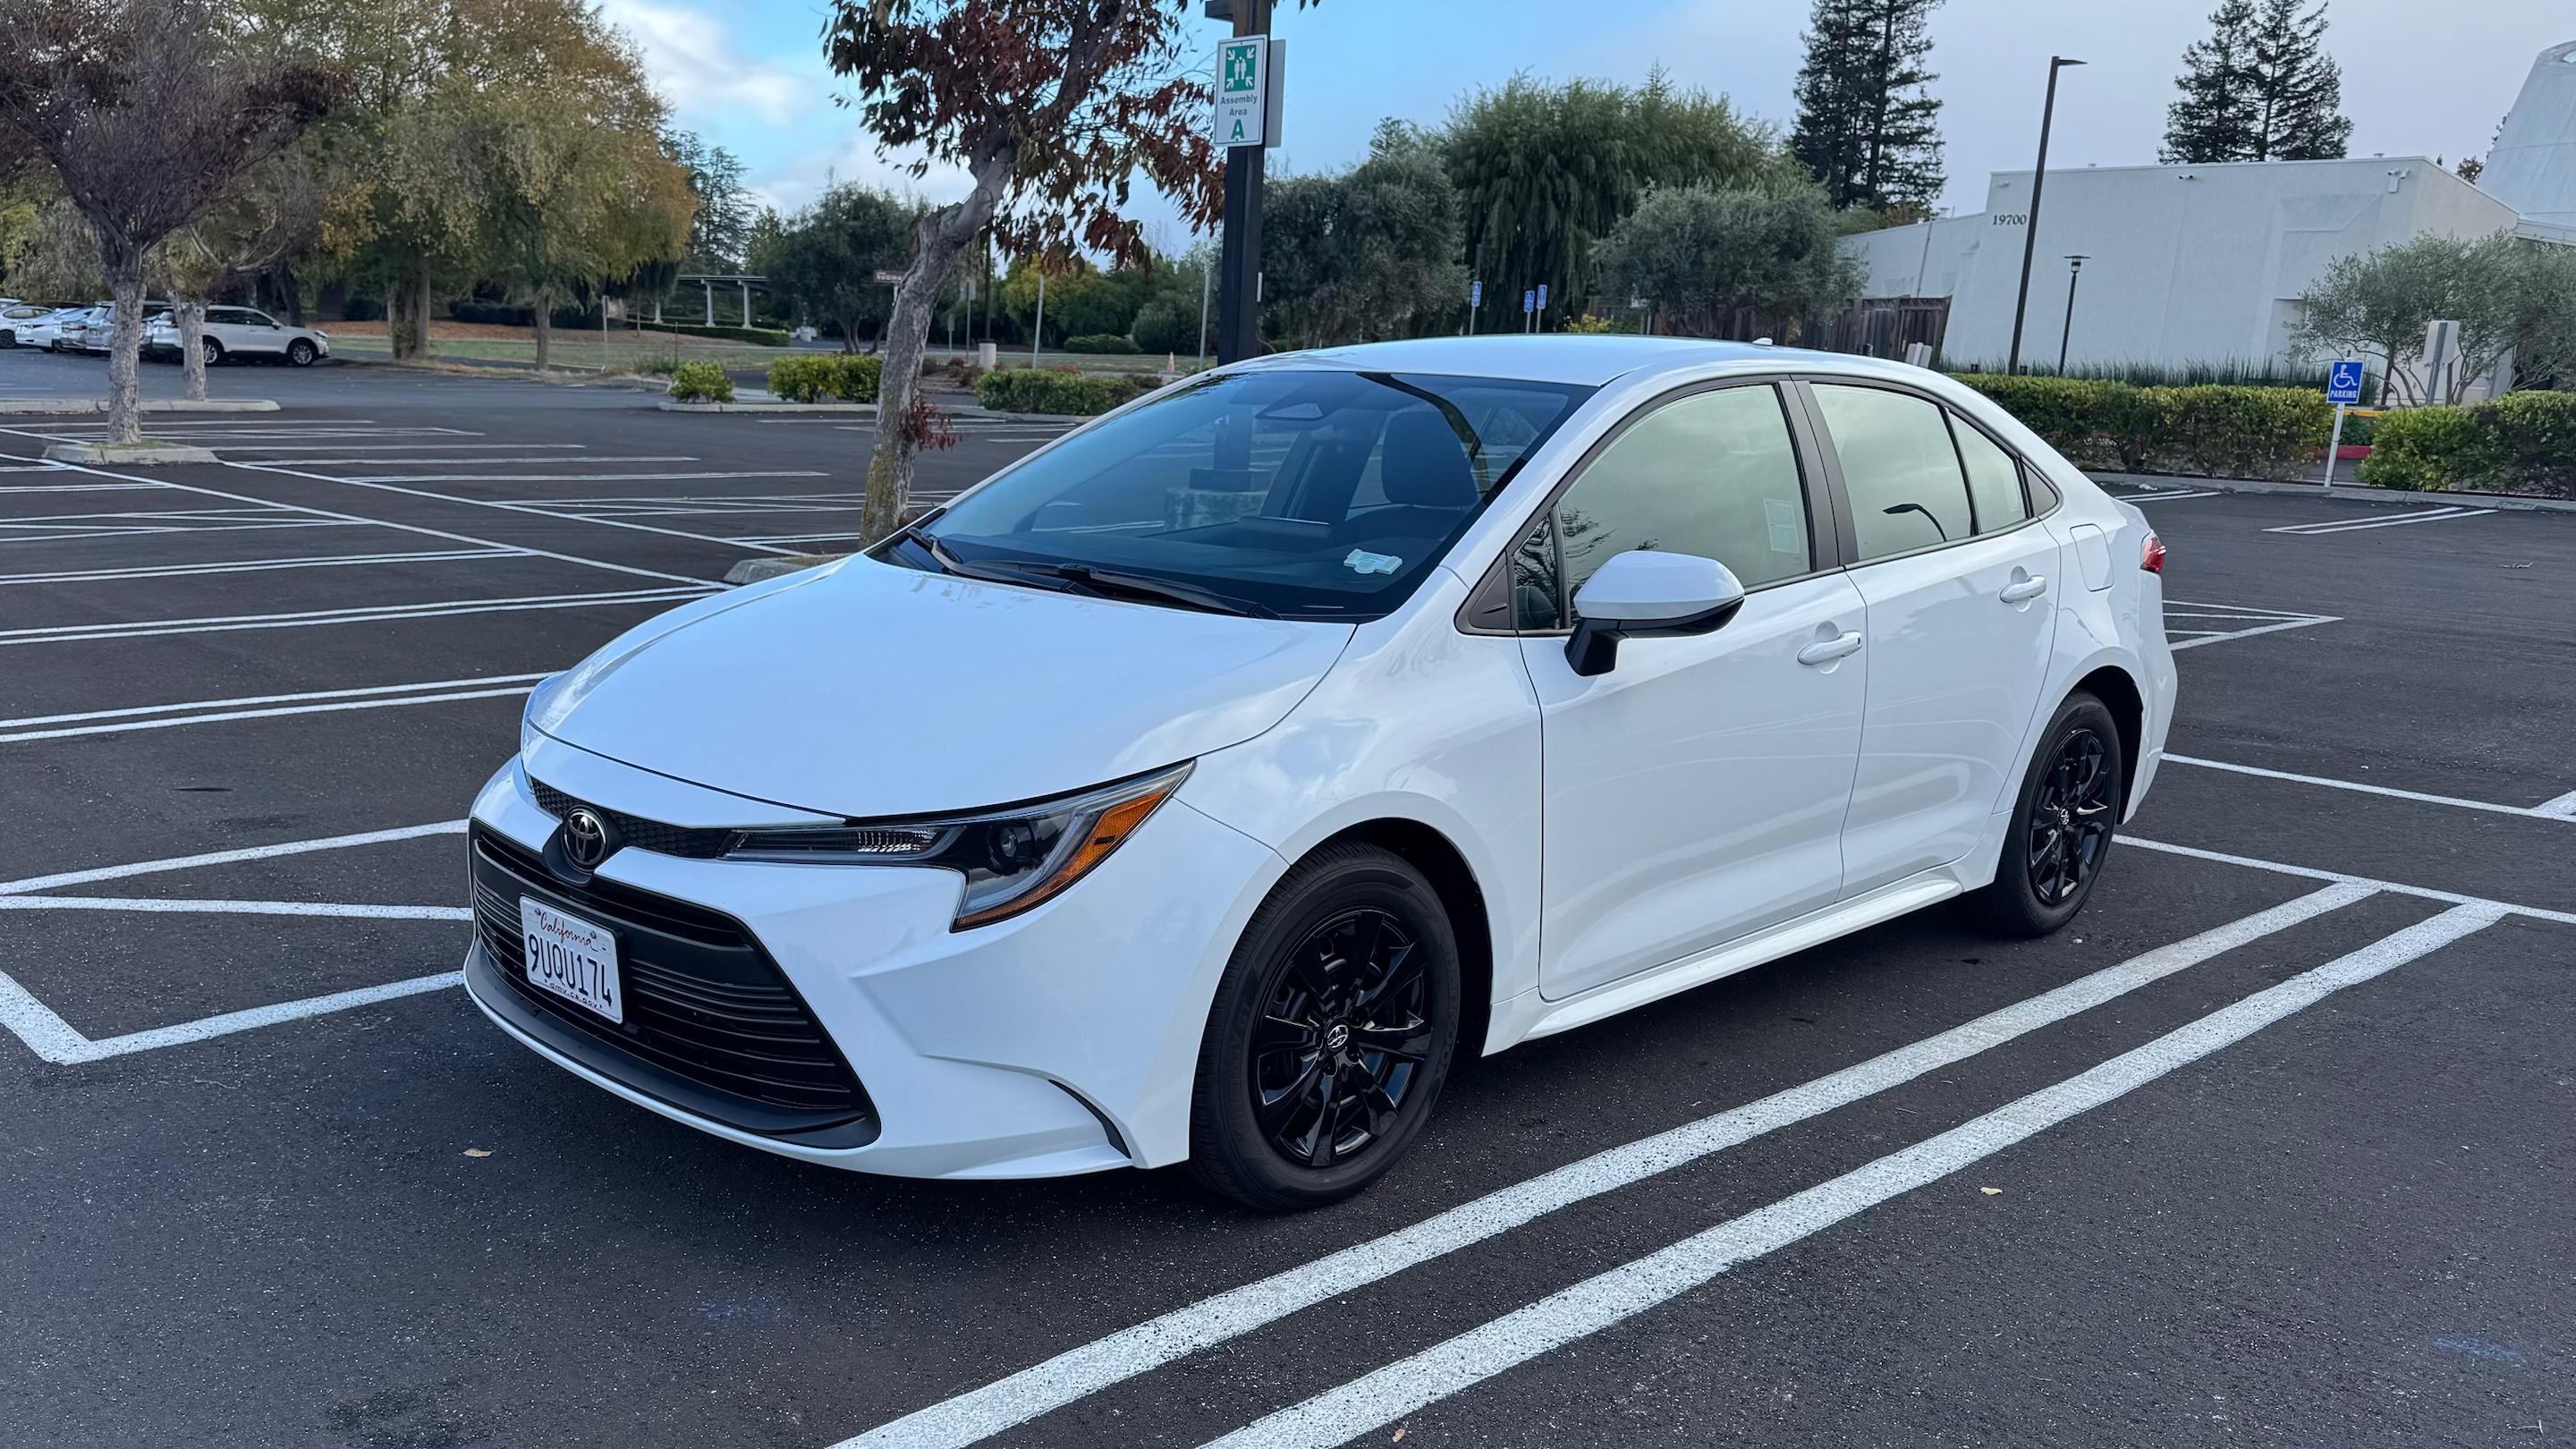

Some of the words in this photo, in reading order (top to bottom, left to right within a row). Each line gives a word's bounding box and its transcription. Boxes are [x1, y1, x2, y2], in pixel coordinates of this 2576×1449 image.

[1220, 95, 1258, 106] Assembly
[1229, 108, 1248, 116] Area
[1231, 119, 1244, 139] A
[1993, 215, 2027, 225] 19700
[2330, 390, 2358, 399] PARKING
[540, 911, 598, 952] California
[529, 934, 612, 1007] 9UQU174
